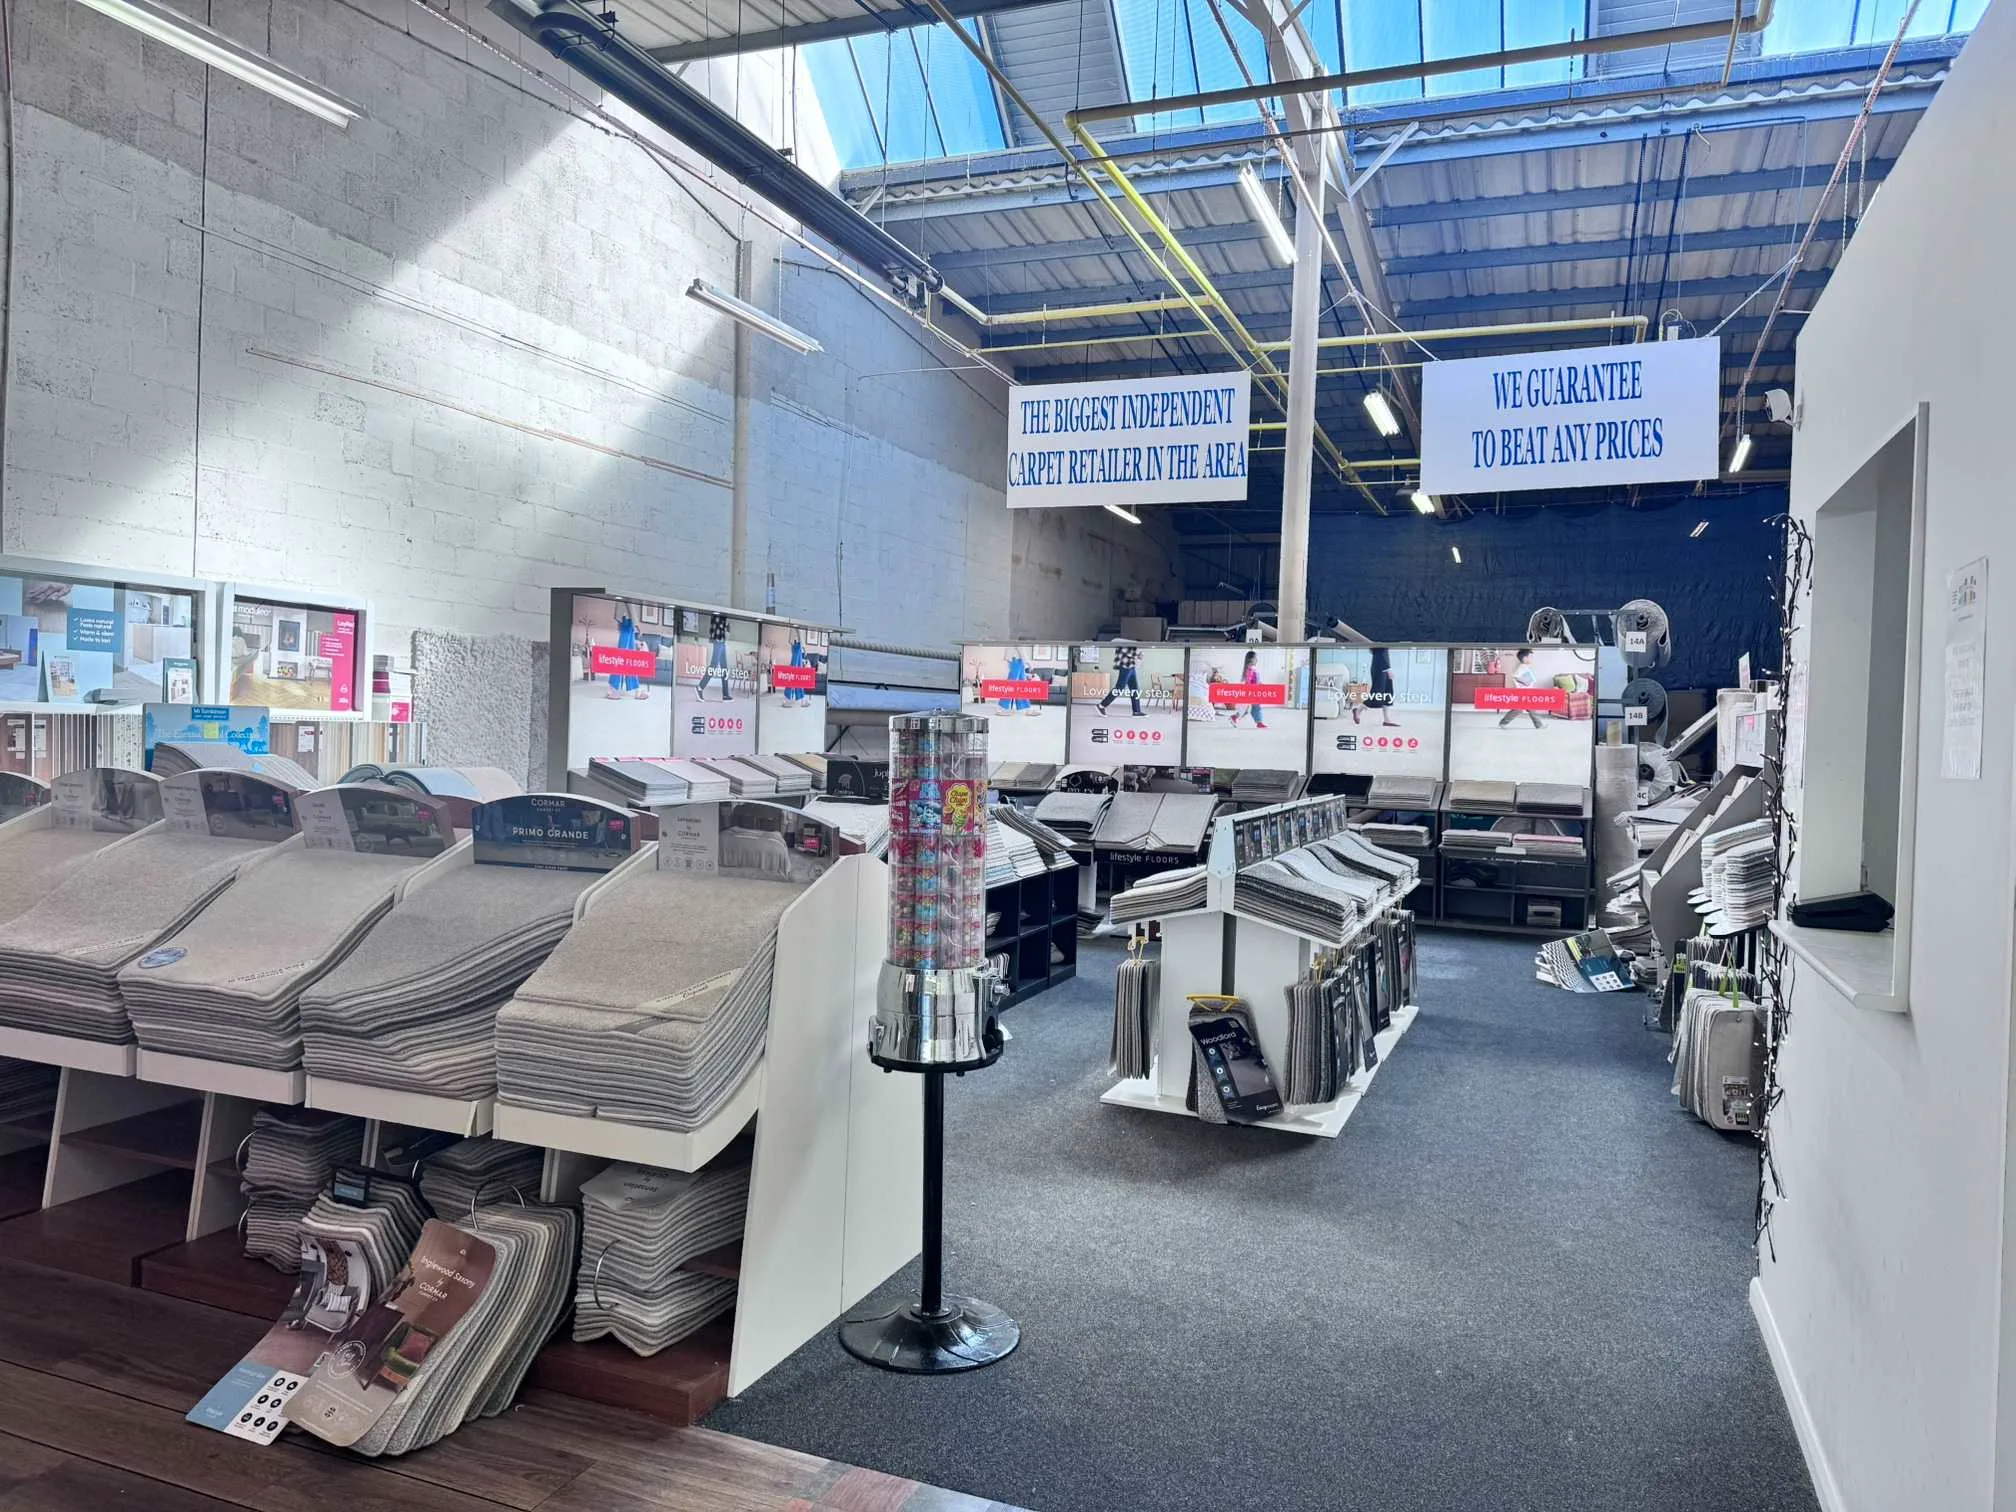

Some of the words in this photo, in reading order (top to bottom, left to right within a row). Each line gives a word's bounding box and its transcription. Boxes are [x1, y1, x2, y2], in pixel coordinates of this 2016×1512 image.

[1492, 370, 1522, 410] WE
[1527, 360, 1642, 407] GUARANTEE
[1021, 399, 1050, 435] THE
[1053, 395, 1119, 433] BIGGEST
[1121, 388, 1235, 430] INDEPENDENT
[1472, 429, 1496, 468] TO
[1500, 426, 1548, 466] BEAT
[1551, 423, 1591, 463] ANY
[1595, 417, 1663, 461] PRICES
[1008, 450, 1065, 487] CARPET
[1068, 446, 1142, 484] RETAILER
[1146, 445, 1164, 481] IN
[1167, 444, 1198, 480] THE
[1203, 441, 1247, 478] AREA
[599, 652, 624, 666] lifestyle
[625, 656, 649, 668] FLOORS
[685, 662, 706, 675] Love
[707, 664, 730, 679] every
[777, 670, 795, 681] lifestyle
[795, 673, 812, 681] FLOORS
[988, 683, 1014, 695] lifestyle
[1016, 686, 1041, 694] FLOORS
[1083, 686, 1108, 697] Love
[1112, 687, 1142, 699] every
[1145, 687, 1173, 699] step.
[1216, 686, 1246, 699] lifestyle
[1248, 690, 1278, 698] FLOORS
[1328, 689, 1357, 701] Love
[1360, 691, 1395, 704] every
[1400, 691, 1432, 704] step.
[1484, 693, 1519, 704] lifestyle
[1522, 695, 1556, 703] FLOORS
[531, 798, 565, 808] CORMAR
[512, 827, 544, 837] PRIMO
[547, 829, 589, 840] GRANDE
[1110, 851, 1142, 864] lifestyle
[1145, 853, 1179, 865] FLOORS
[419, 1281, 448, 1299] CORMAR
